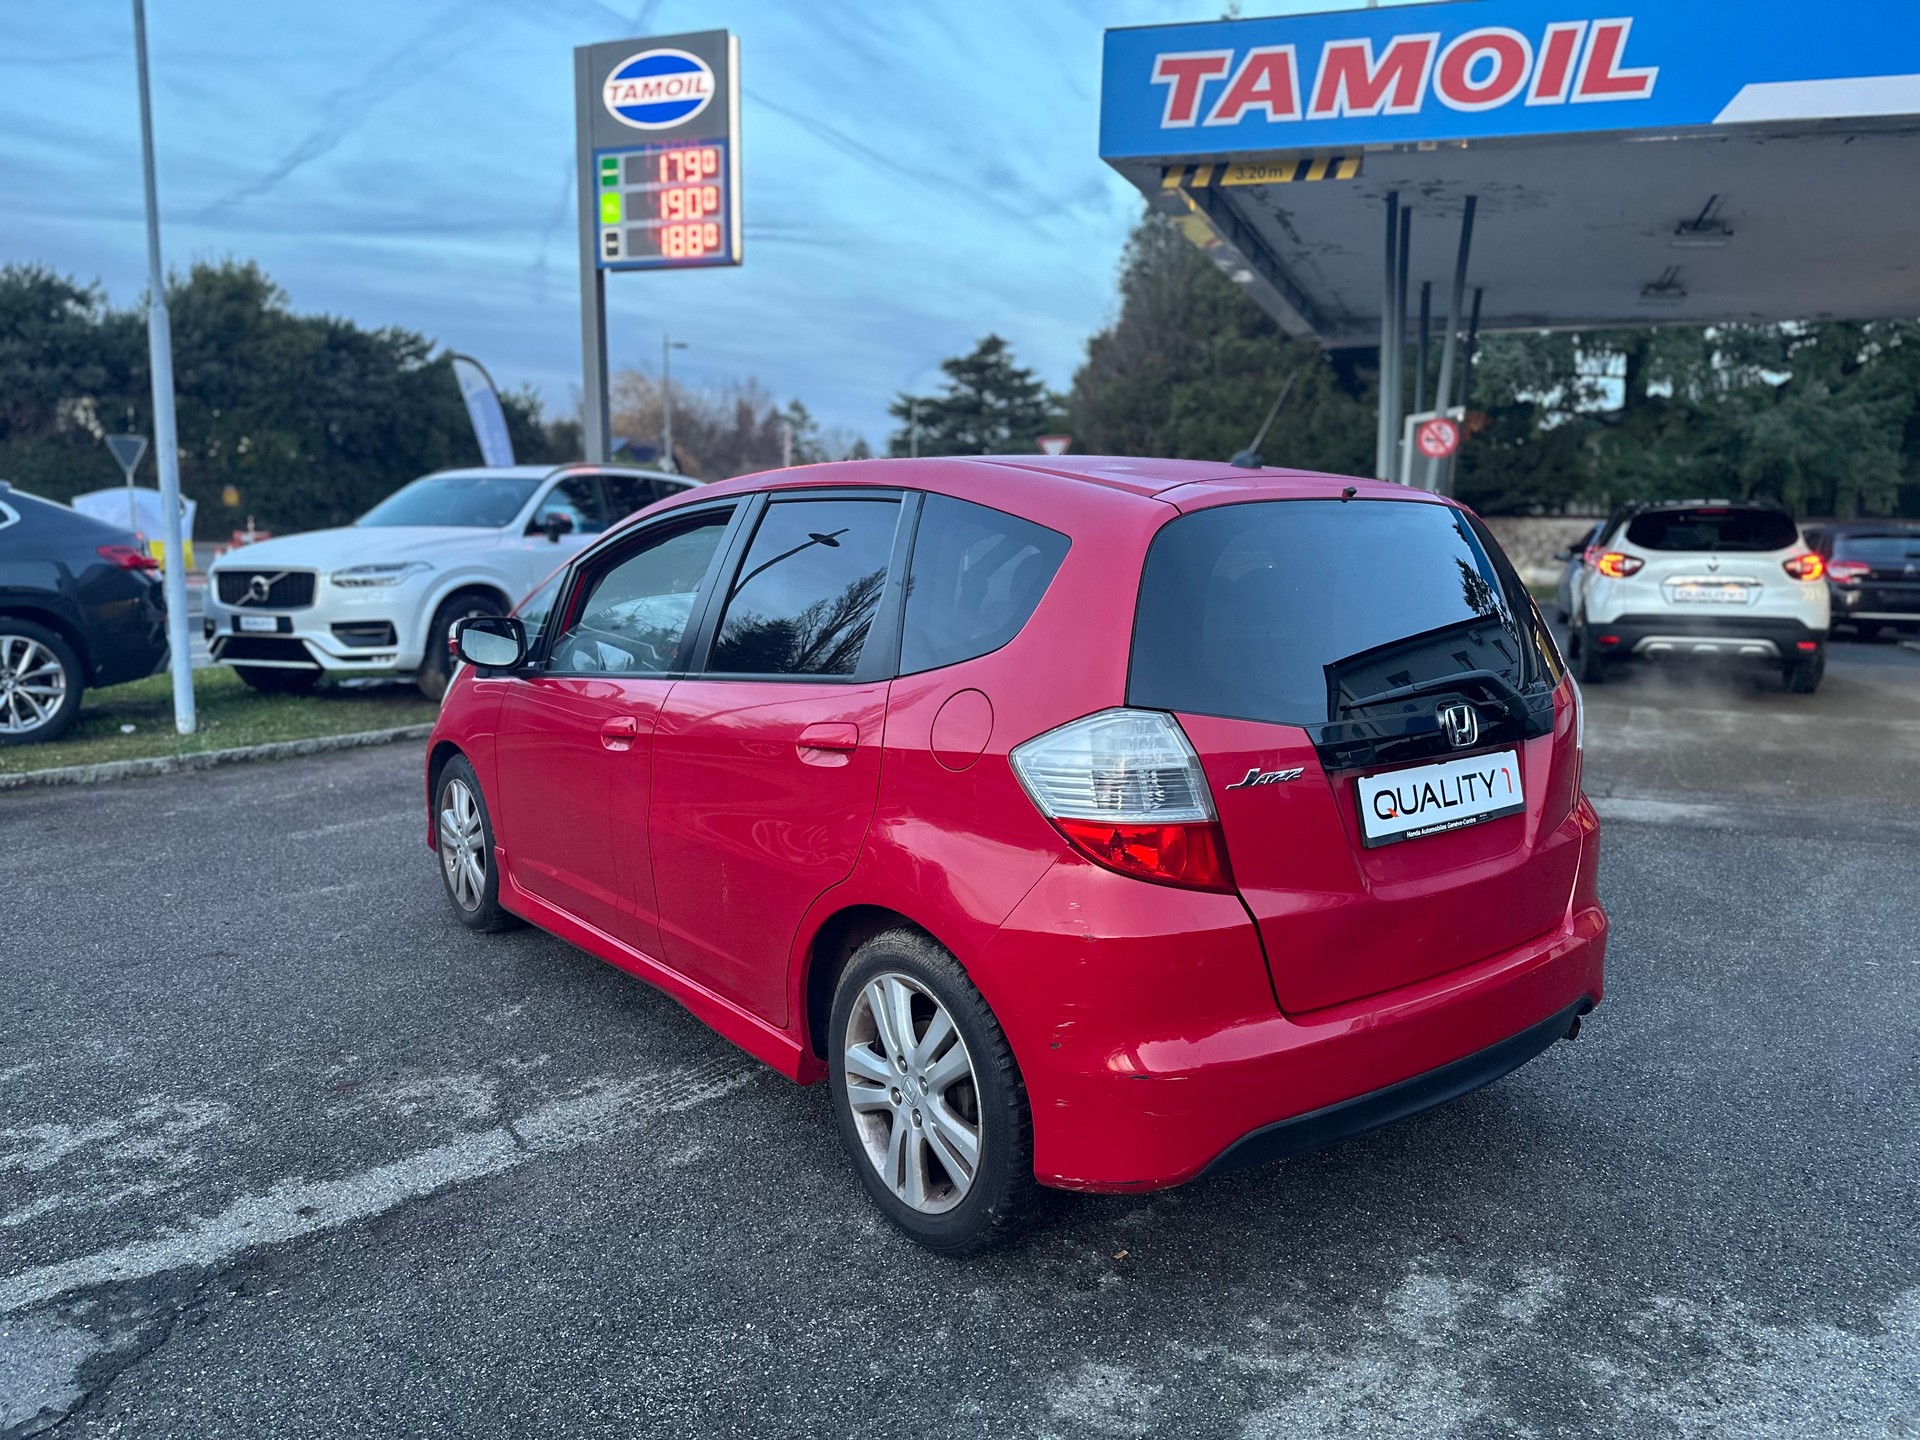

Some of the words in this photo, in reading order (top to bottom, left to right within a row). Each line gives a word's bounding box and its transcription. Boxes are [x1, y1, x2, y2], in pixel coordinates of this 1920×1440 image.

[1150, 17, 1659, 128] TAMOIL
[609, 77, 708, 102] TAMOIL
[1406, 830, 1421, 838] Honda
[1421, 824, 1446, 835] Automobiles
